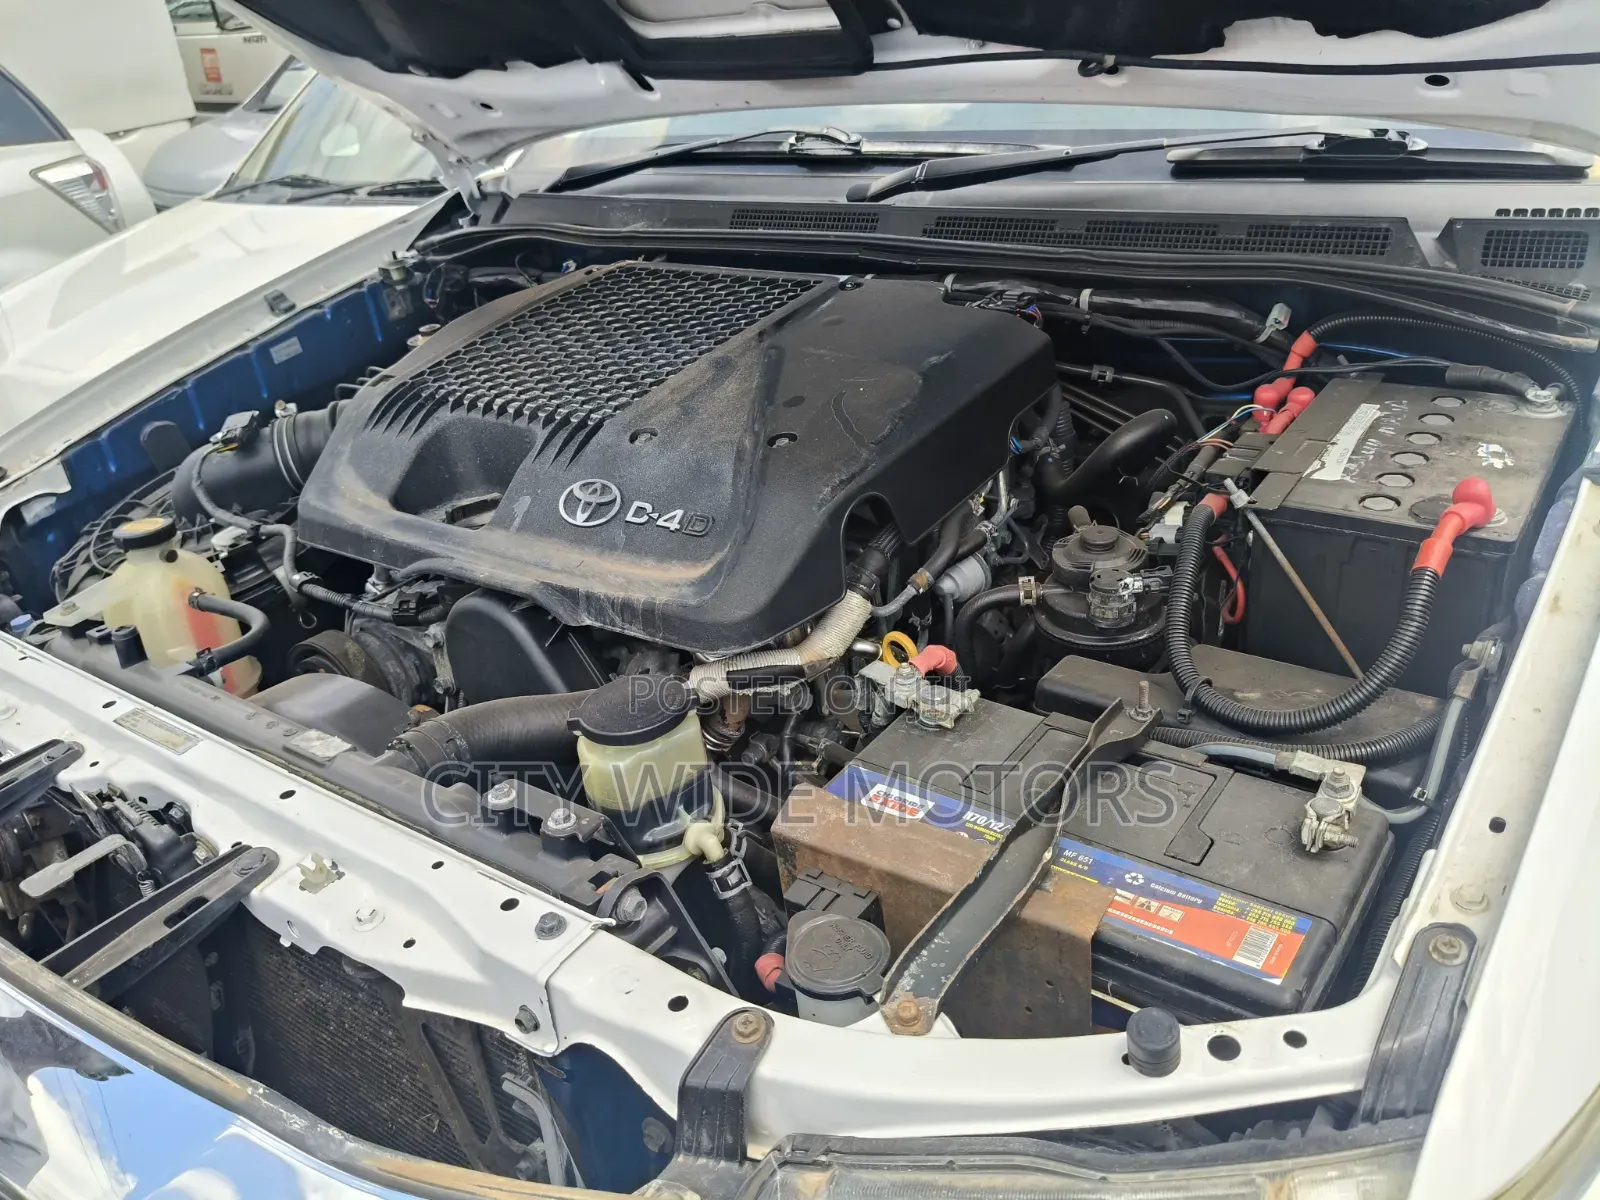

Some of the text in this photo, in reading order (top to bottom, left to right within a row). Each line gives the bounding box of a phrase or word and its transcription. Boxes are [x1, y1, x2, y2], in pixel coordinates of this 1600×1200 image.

[624, 500, 715, 537] D-4D
[870, 794, 921, 817] EXIDE
[876, 790, 925, 809] CHLORIDE
[1063, 849, 1078, 858] MF
